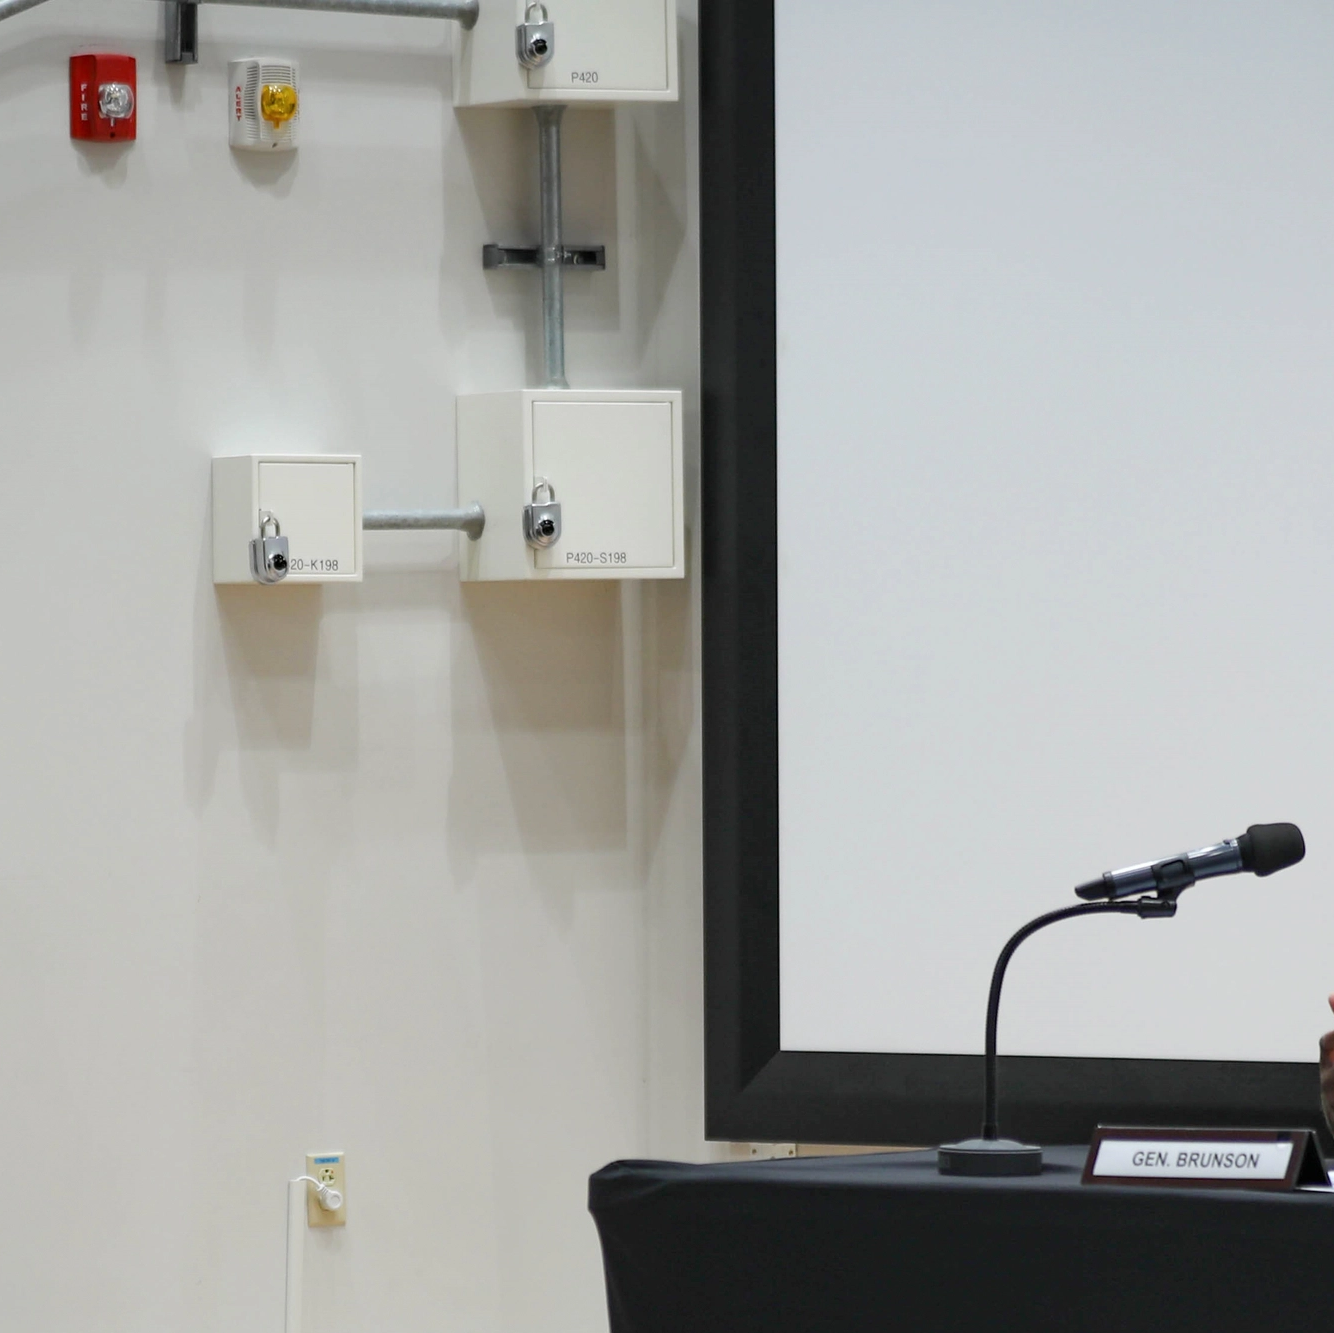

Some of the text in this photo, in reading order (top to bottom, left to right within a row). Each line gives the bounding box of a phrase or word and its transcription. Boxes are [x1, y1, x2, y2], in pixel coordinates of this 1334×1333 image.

[571, 72, 599, 83] P420
[80, 83, 88, 121] FIRE
[235, 86, 243, 121] ALERT
[290, 559, 339, 572] 20-K198
[566, 552, 627, 564] P420-S198
[1132, 1151, 1260, 1169] GEN. BRUNSON
